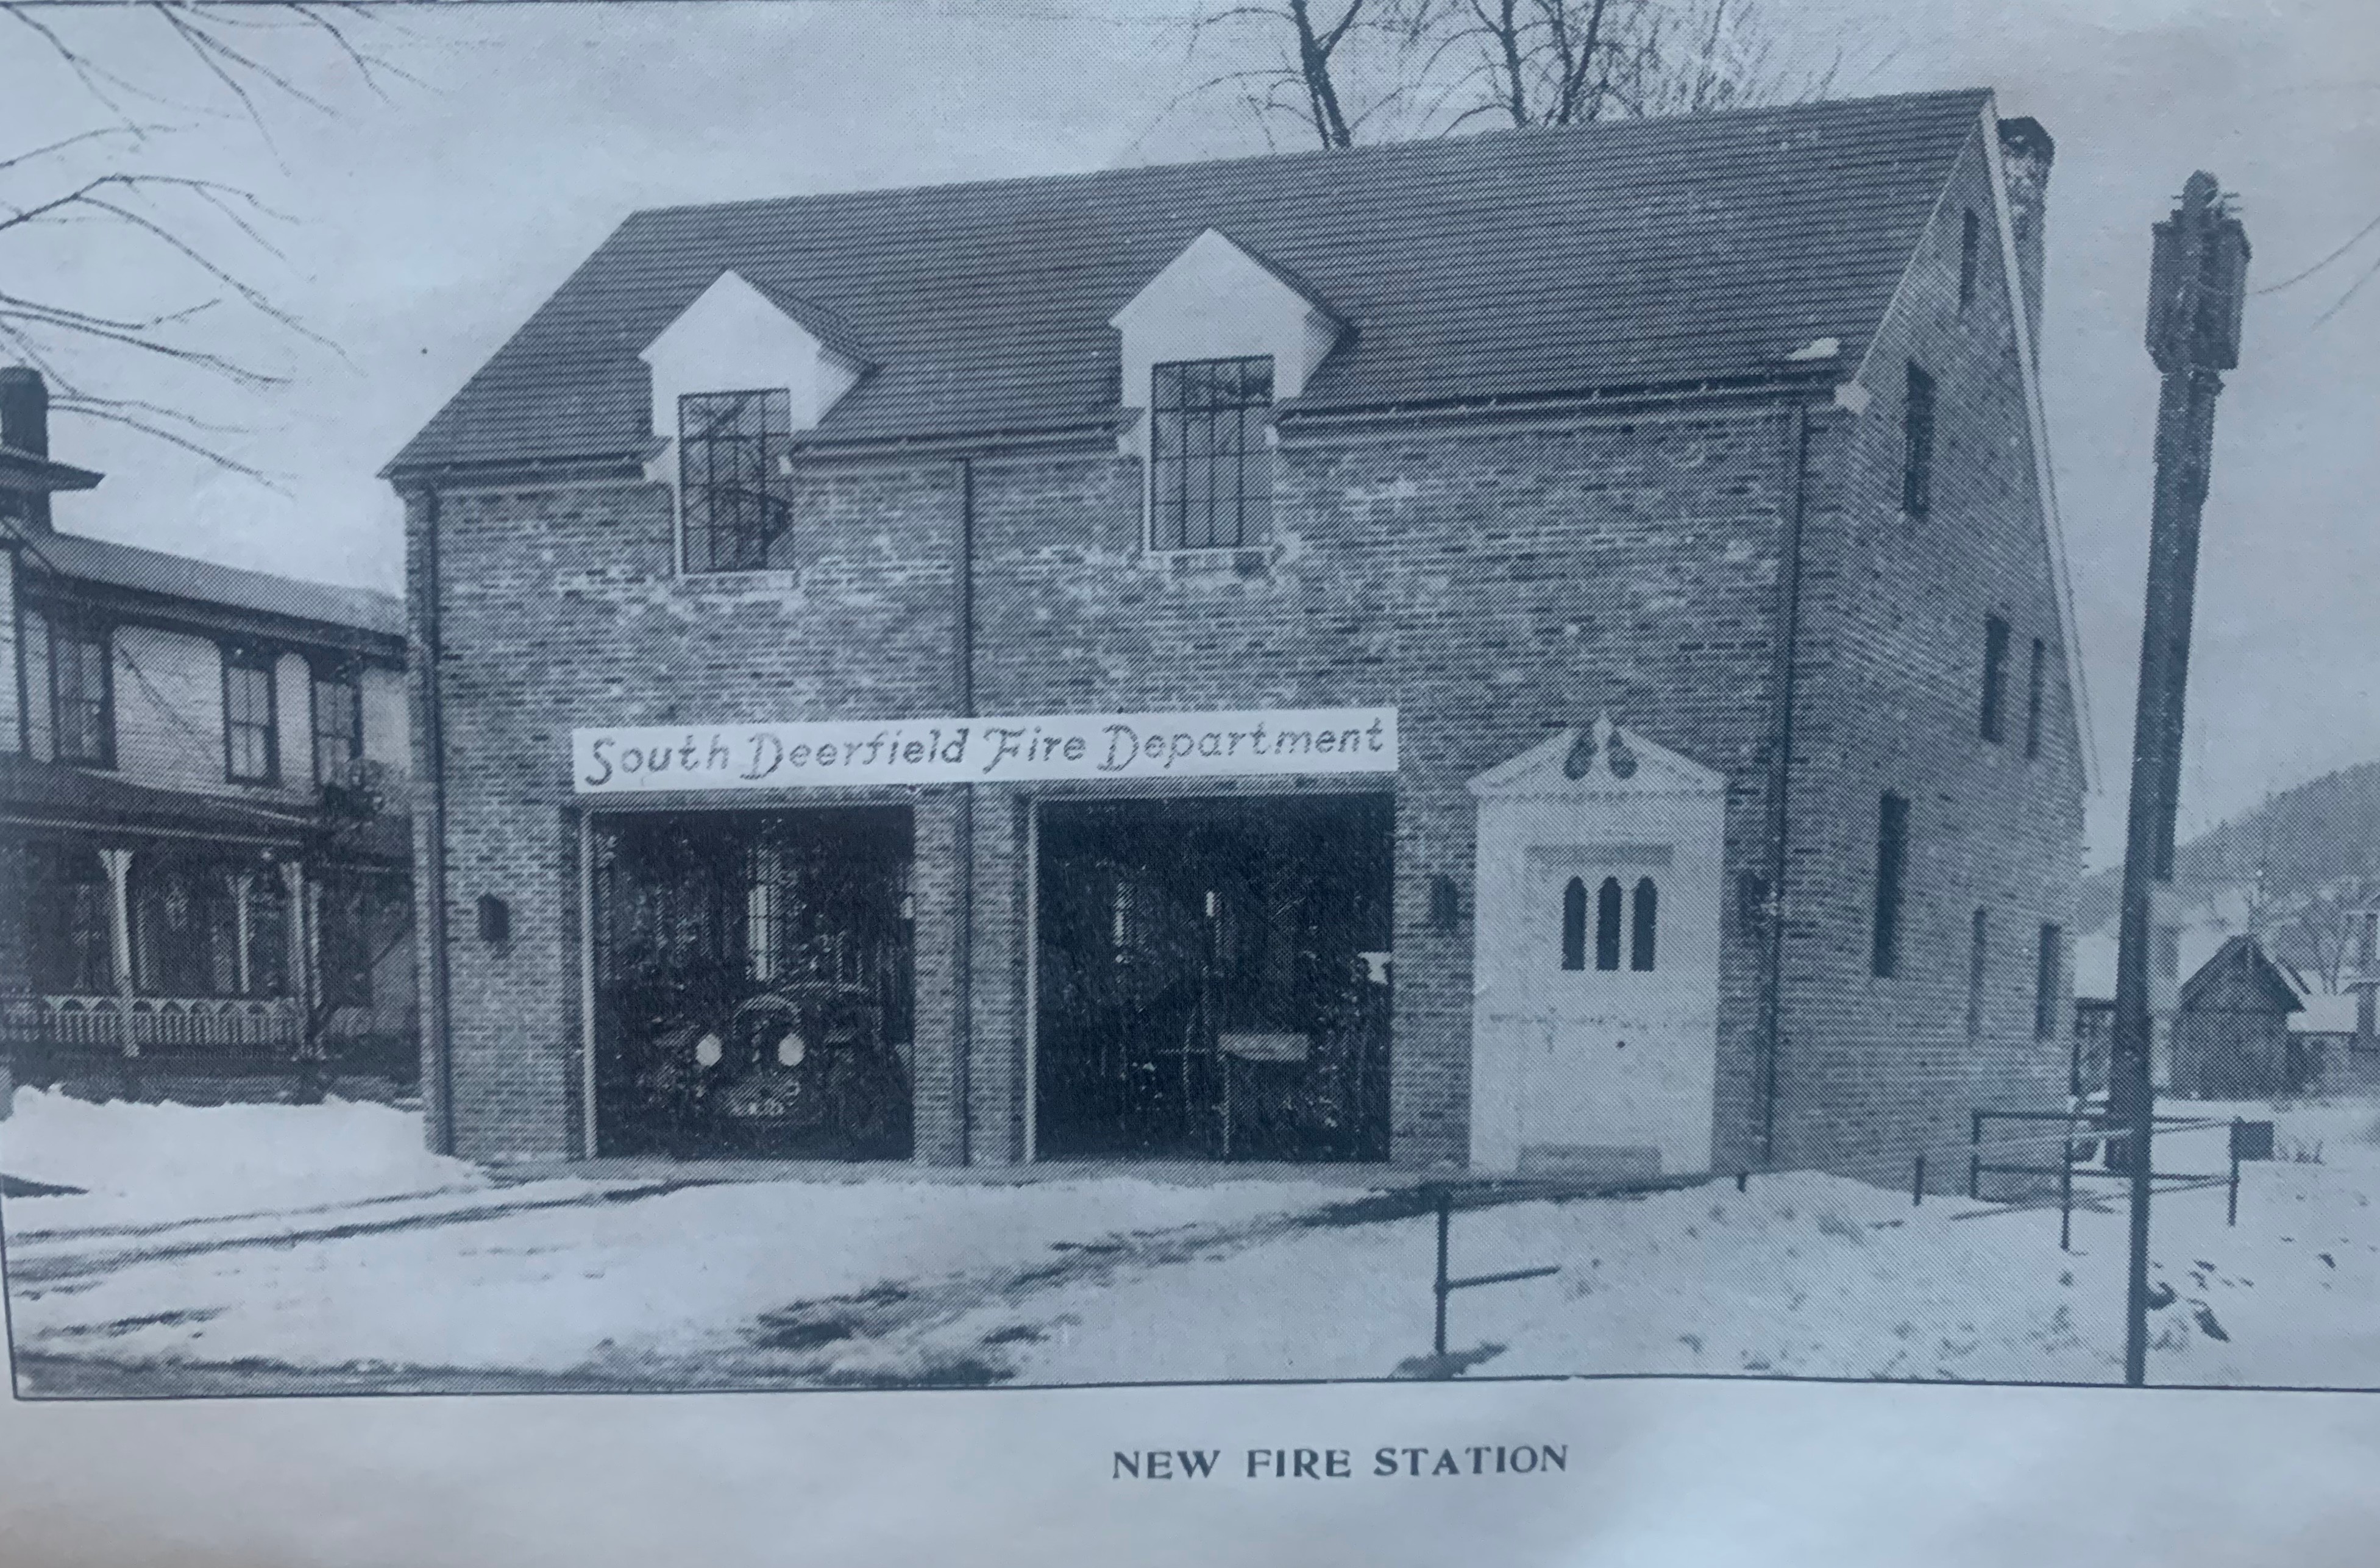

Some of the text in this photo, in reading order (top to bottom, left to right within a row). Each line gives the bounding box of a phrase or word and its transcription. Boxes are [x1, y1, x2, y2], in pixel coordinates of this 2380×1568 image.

[585, 717, 1385, 786] South Deerfield Fire Department
[1112, 1444, 1569, 1480] NEW FIRE STATION
